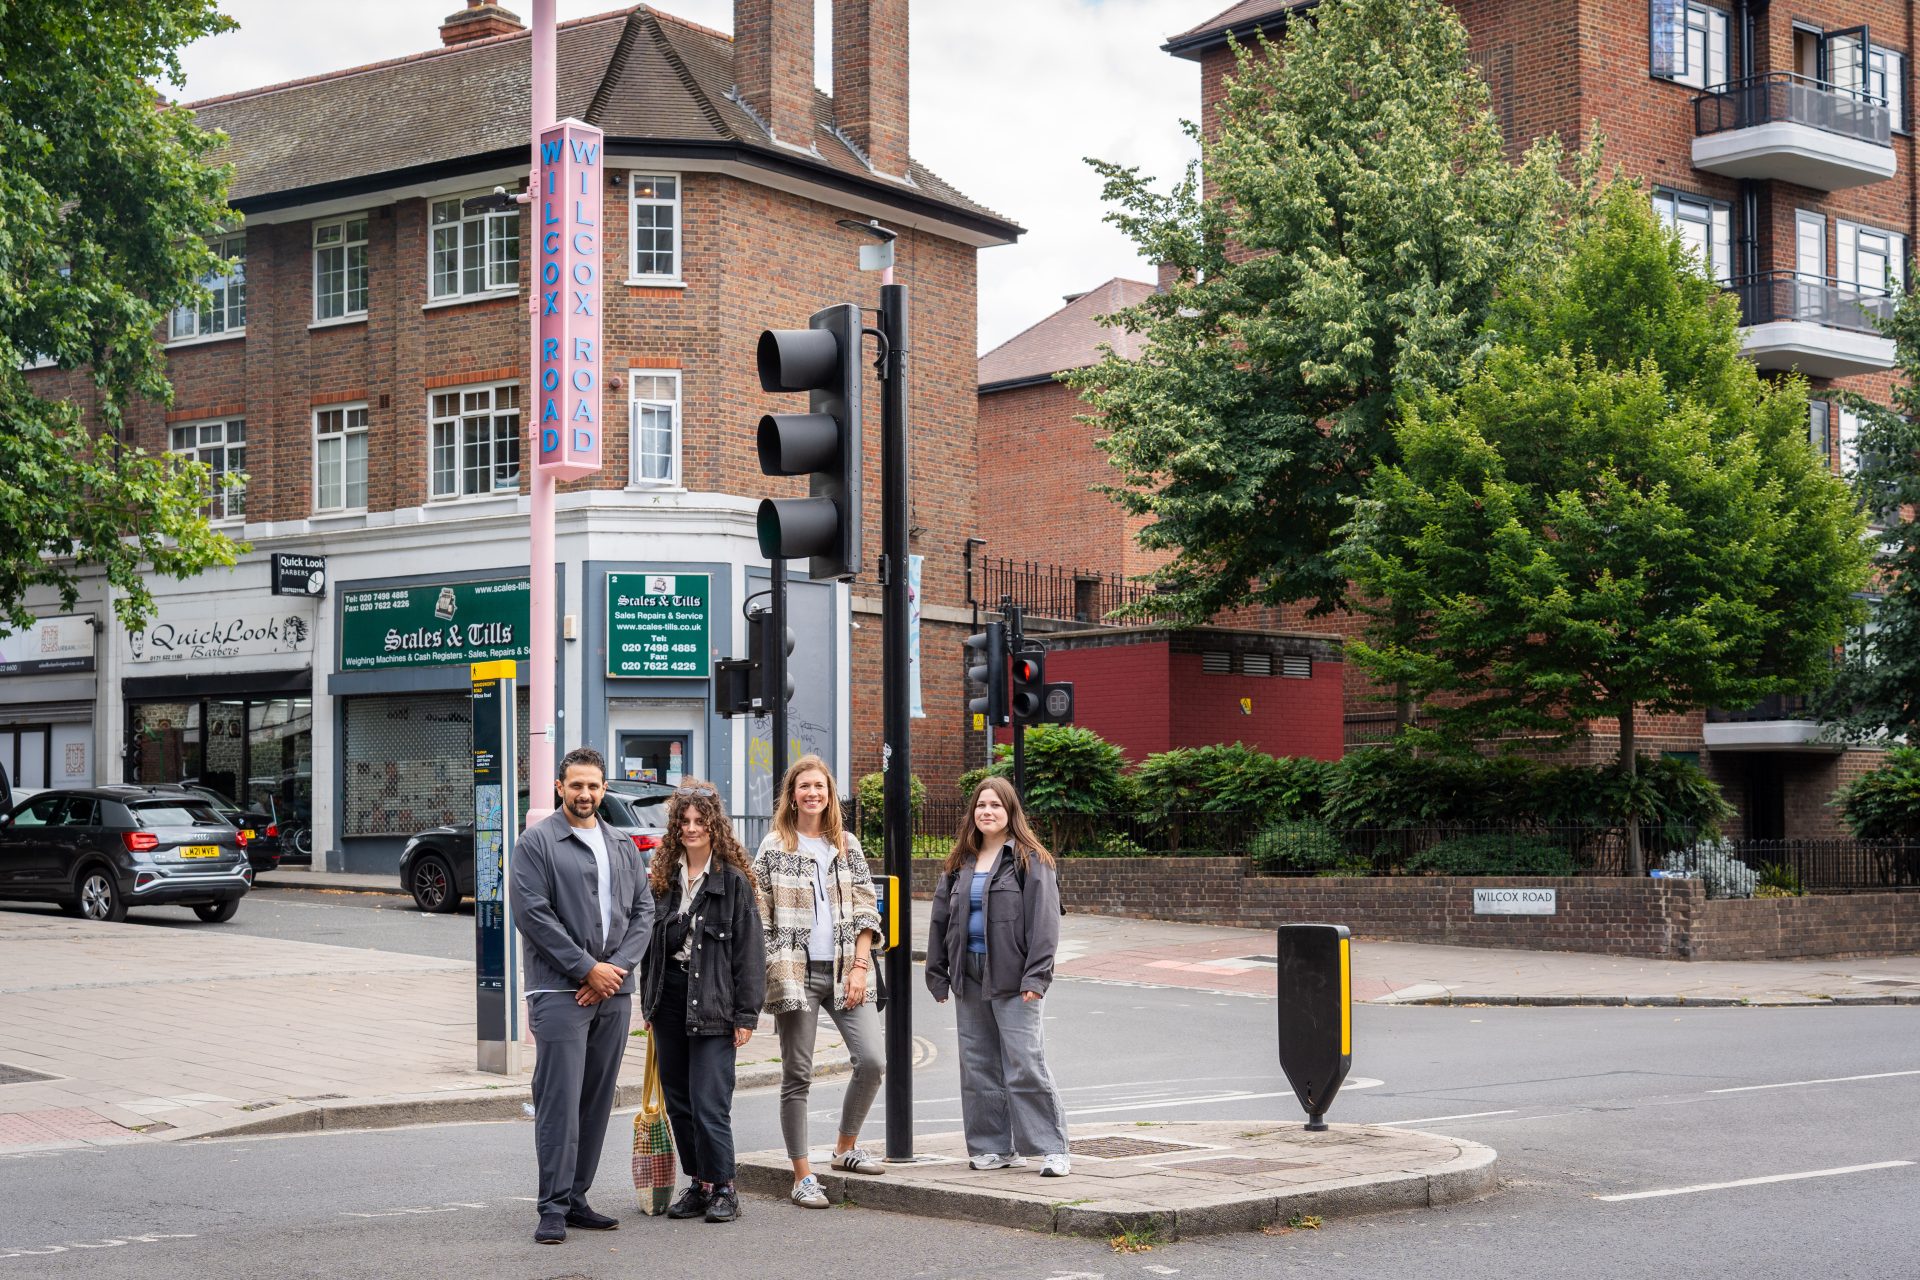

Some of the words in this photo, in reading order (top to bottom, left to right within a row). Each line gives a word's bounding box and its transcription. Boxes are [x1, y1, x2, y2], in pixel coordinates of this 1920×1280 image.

[541, 139, 563, 316] WILCOX
[570, 138, 598, 316] WILCOX
[543, 337, 559, 452] ROAD
[573, 337, 594, 452] ROAD
[280, 556, 304, 567] Quick
[305, 558, 325, 568] Look
[345, 595, 358, 603] Tel:
[359, 594, 372, 602] 020
[617, 594, 656, 607] Scales
[658, 594, 670, 606] &
[672, 595, 702, 607] Tills
[344, 604, 359, 612] Fax:
[360, 603, 373, 611] 020
[374, 601, 391, 610] 7622
[392, 600, 410, 608] 4226
[614, 611, 636, 620] Sales
[637, 612, 666, 621] Repairs
[667, 612, 674, 620] &
[675, 612, 704, 620] Service
[617, 623, 701, 631] www.scales-tills.co.uk
[384, 627, 442, 651] Scales
[446, 624, 463, 648] &
[467, 623, 512, 646] Tills
[651, 634, 667, 642] Tel:
[190, 645, 240, 659] Barbers
[621, 643, 641, 652] 020
[643, 643, 669, 652] 7498
[346, 657, 375, 666] Weighing
[375, 654, 406, 664] Machines
[407, 653, 413, 662] &
[414, 652, 431, 661] Cash
[432, 651, 463, 661] Registers
[468, 649, 489, 658] Sales,
[489, 647, 515, 658] Repairs
[516, 646, 522, 655] &
[650, 653, 668, 661] Fax:
[621, 662, 640, 671] 020
[643, 662, 668, 671] 7622
[671, 662, 696, 671] 4226
[202, 846, 216, 855] MVE
[1477, 892, 1518, 902] WILCOX
[1522, 892, 1552, 902] ROAD
